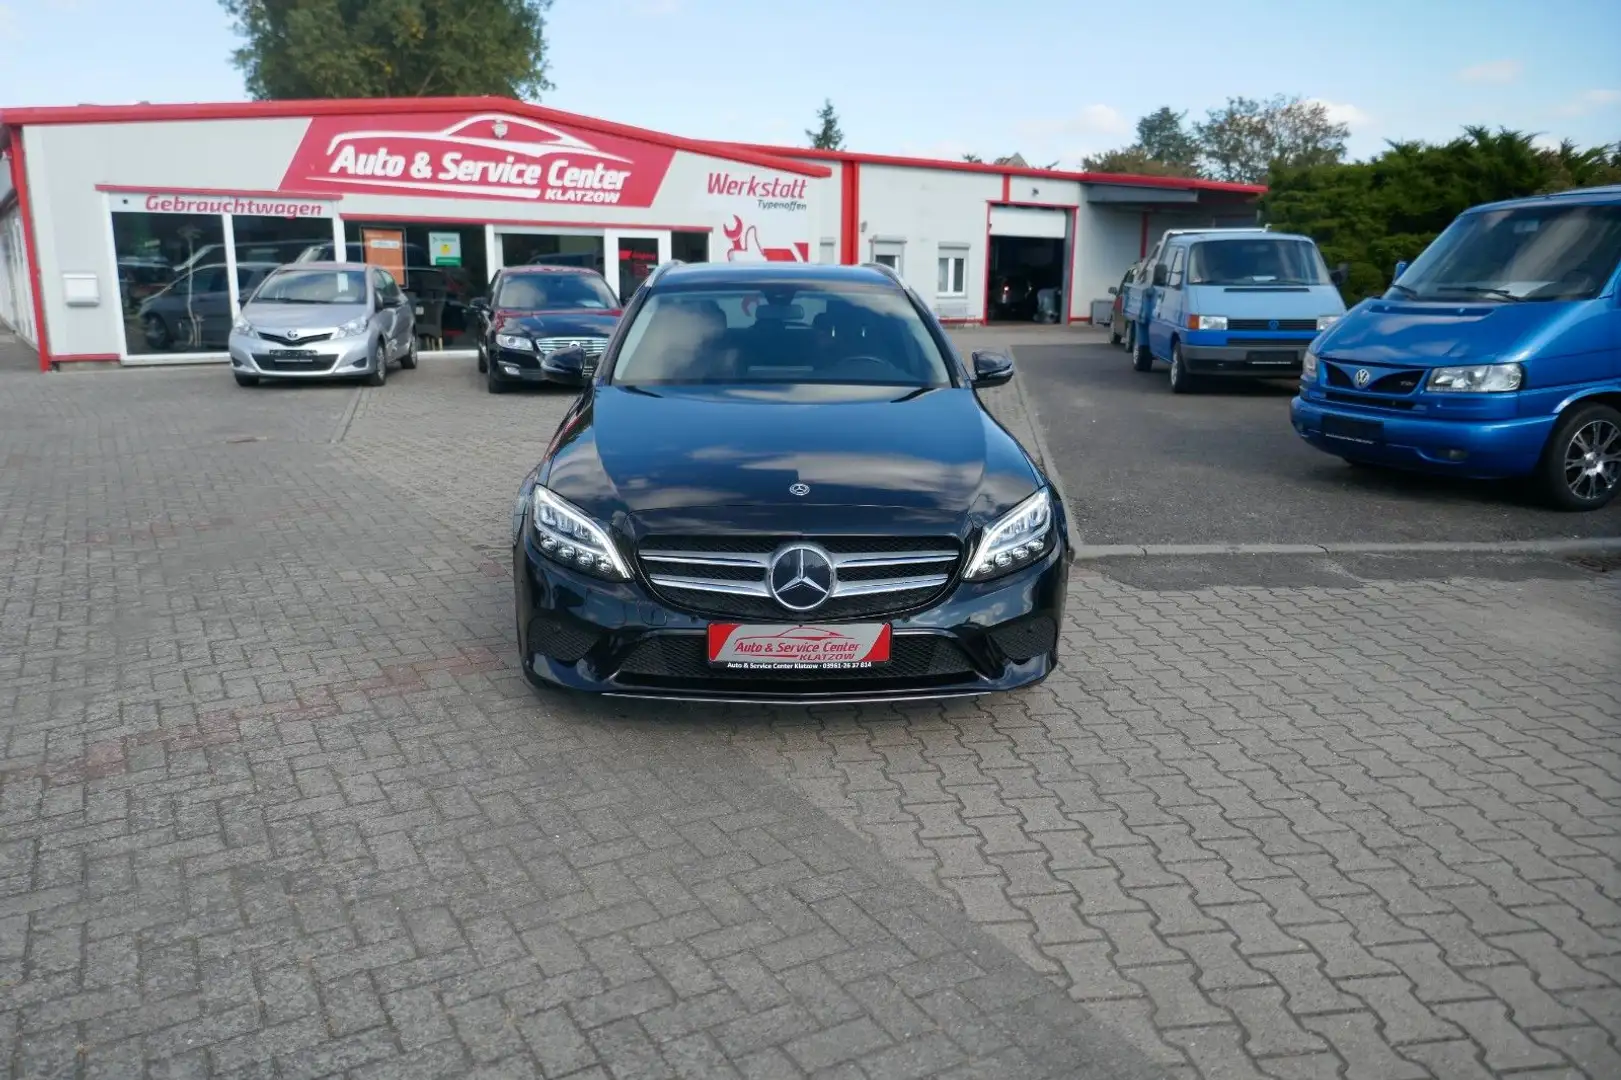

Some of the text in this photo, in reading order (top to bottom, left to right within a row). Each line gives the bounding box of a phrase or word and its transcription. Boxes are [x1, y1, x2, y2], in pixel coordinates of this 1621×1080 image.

[329, 145, 631, 191] Auto & Service Center
[707, 172, 808, 199] Werkstatt
[544, 188, 621, 204] KLATZOW
[145, 193, 323, 219] Gebrauchtwagen
[757, 199, 807, 211] Typenoffen
[734, 641, 861, 653] Auto & Service Center
[799, 653, 855, 661] KLATZOW
[749, 662, 772, 670] Service
